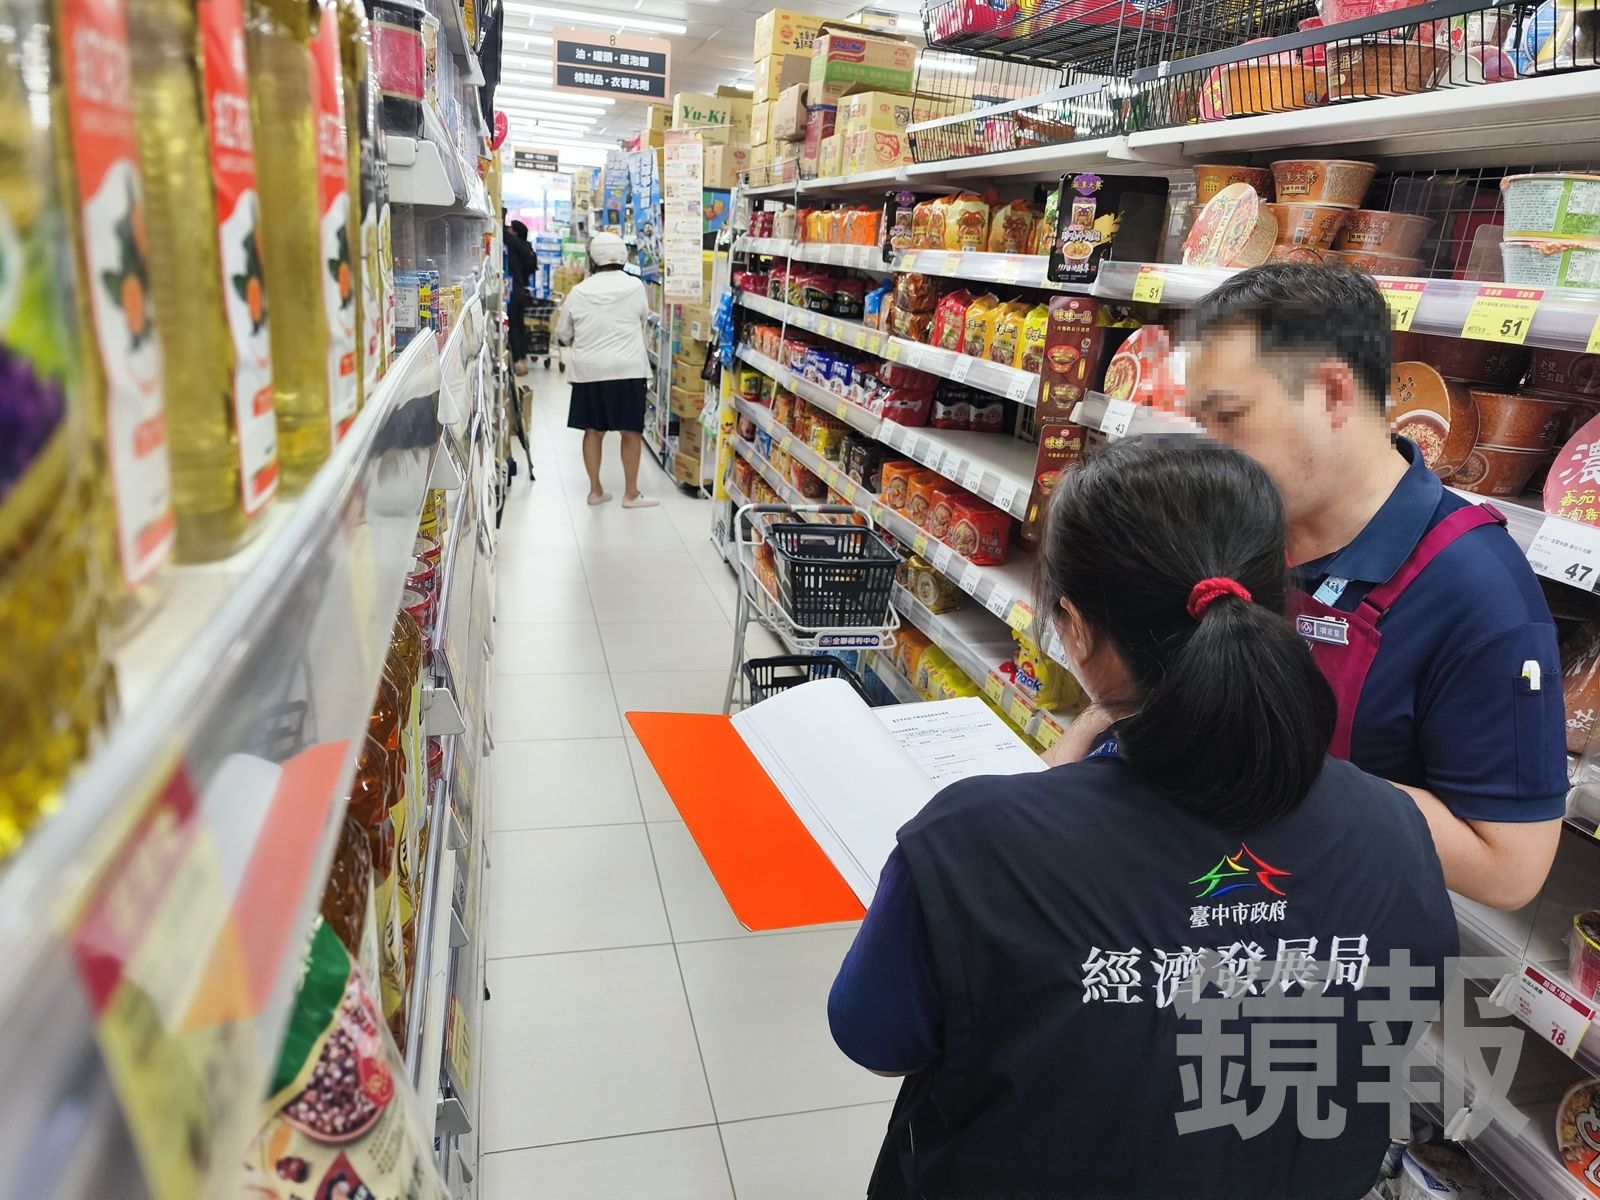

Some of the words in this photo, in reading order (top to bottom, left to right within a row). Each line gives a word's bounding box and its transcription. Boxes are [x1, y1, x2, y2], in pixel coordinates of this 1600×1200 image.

[609, 35, 616, 46] 8
[683, 105, 727, 124] Yu-Ki
[1149, 287, 1160, 299] 51
[1500, 319, 1523, 337] 51
[1115, 423, 1125, 434] 43
[1564, 562, 1593, 582] 47
[832, 636, 878, 646] 全聯福利中心
[1189, 900, 1288, 928] 臺中市政府
[1082, 933, 1371, 1008] 經濟發展局
[1550, 1028, 1566, 1046] 18
